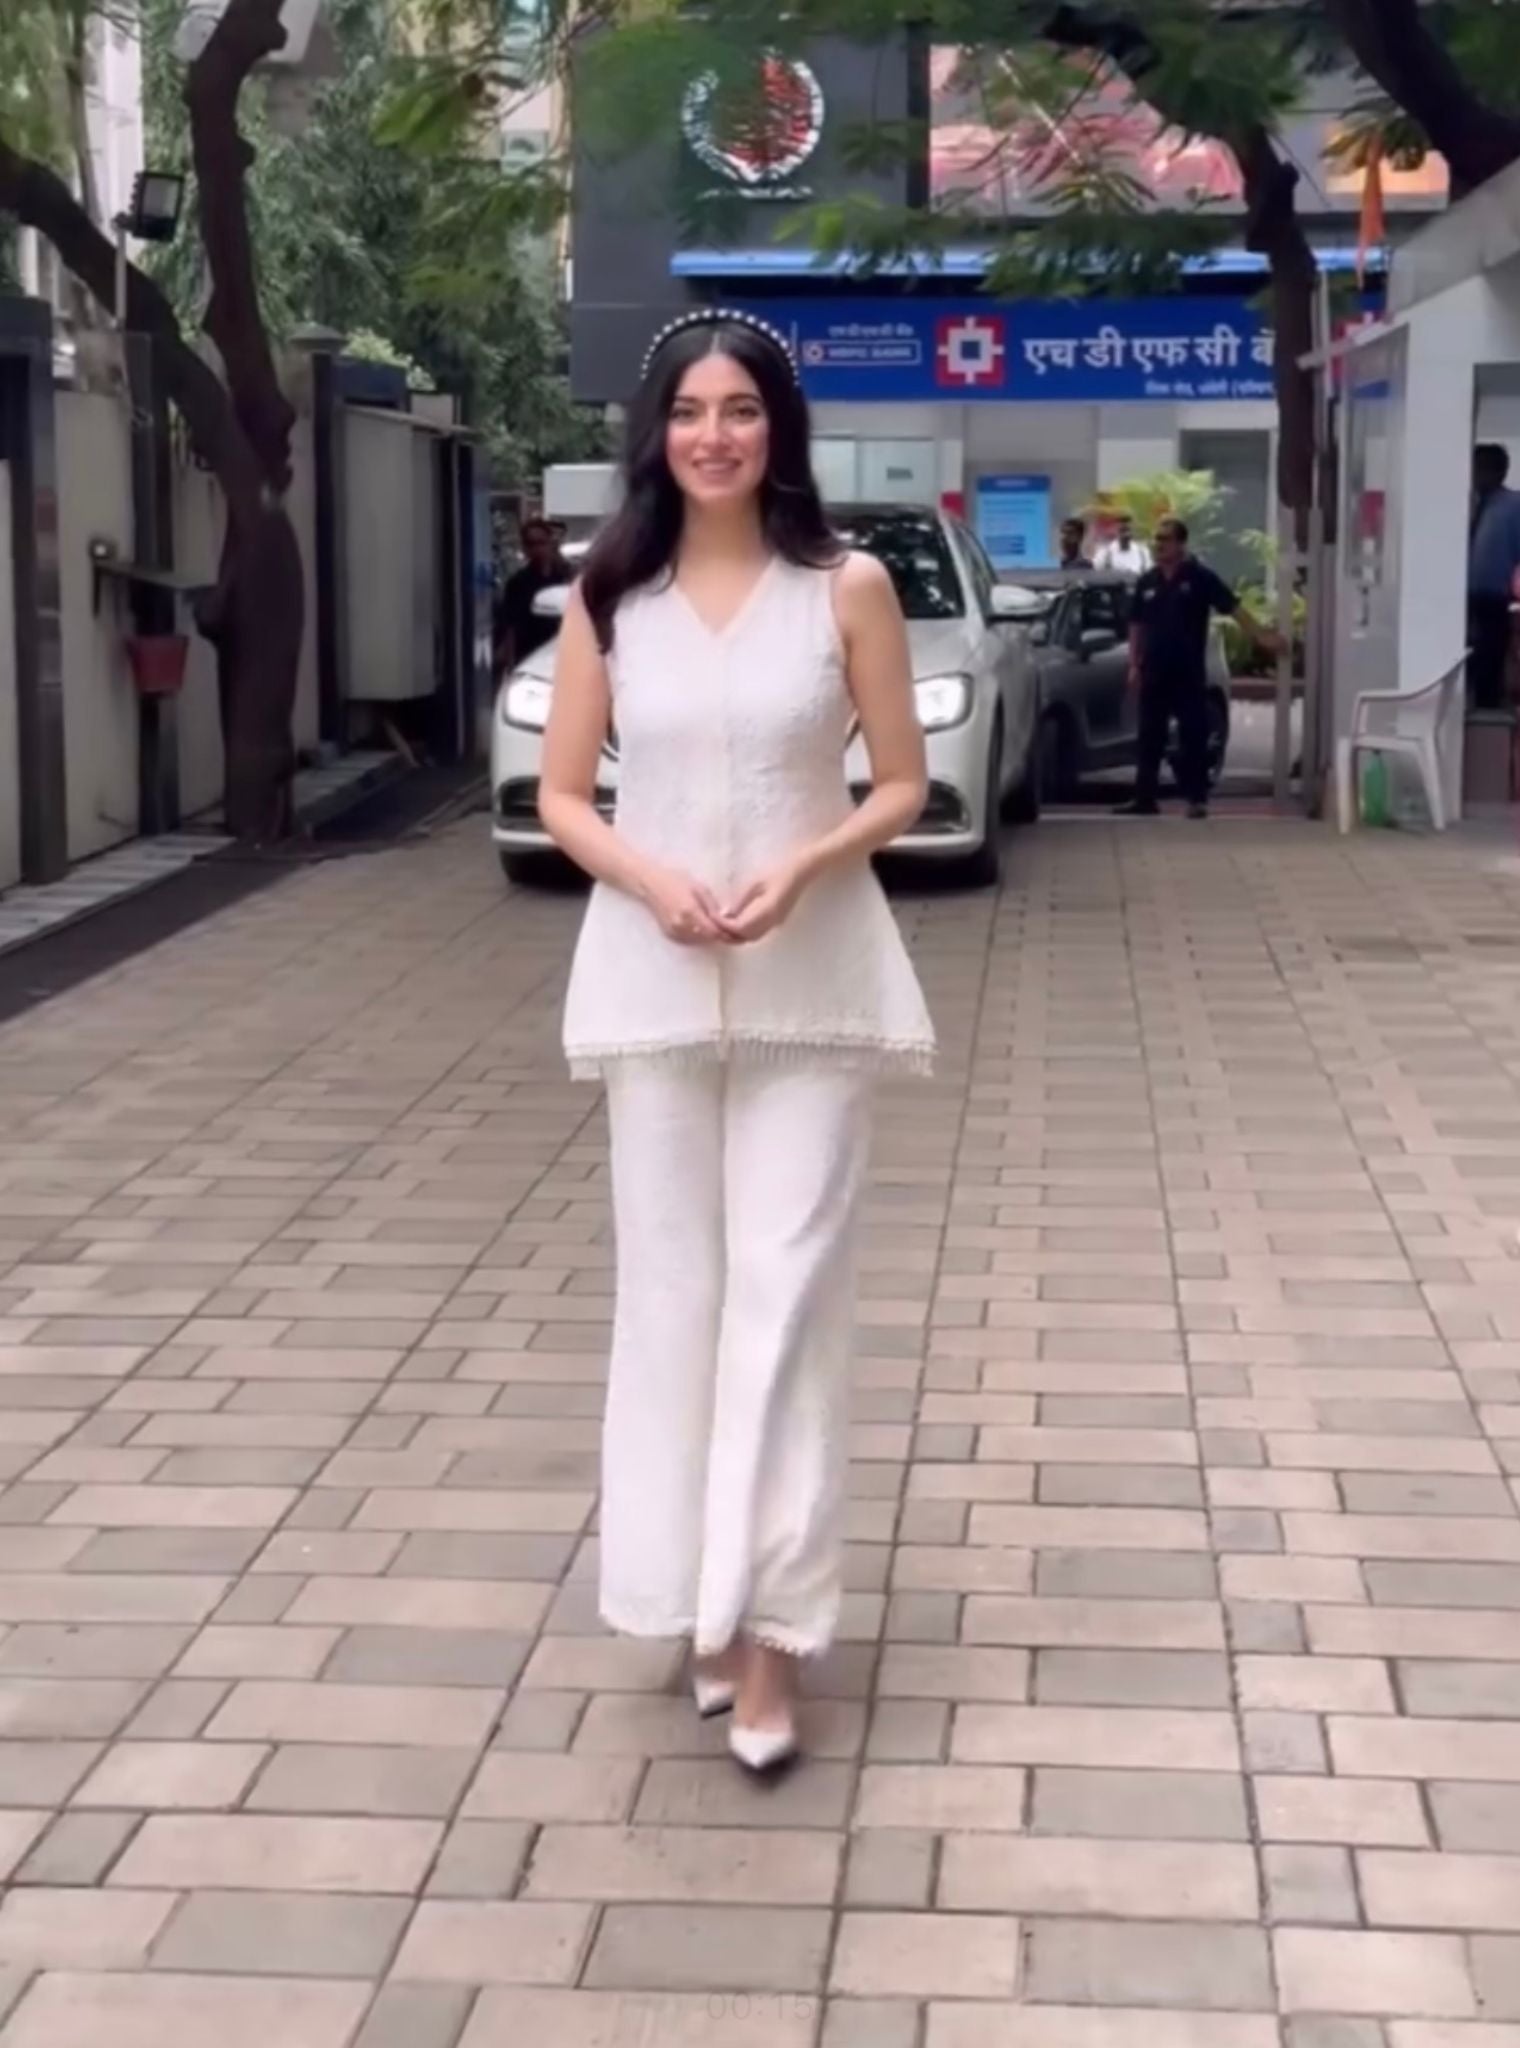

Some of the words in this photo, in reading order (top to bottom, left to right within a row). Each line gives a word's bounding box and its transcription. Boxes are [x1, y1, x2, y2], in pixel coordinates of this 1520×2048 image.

[1022, 337, 1079, 375] एच
[1081, 325, 1127, 368] डी
[1130, 336, 1190, 373] एफ
[1194, 323, 1241, 367] सी
